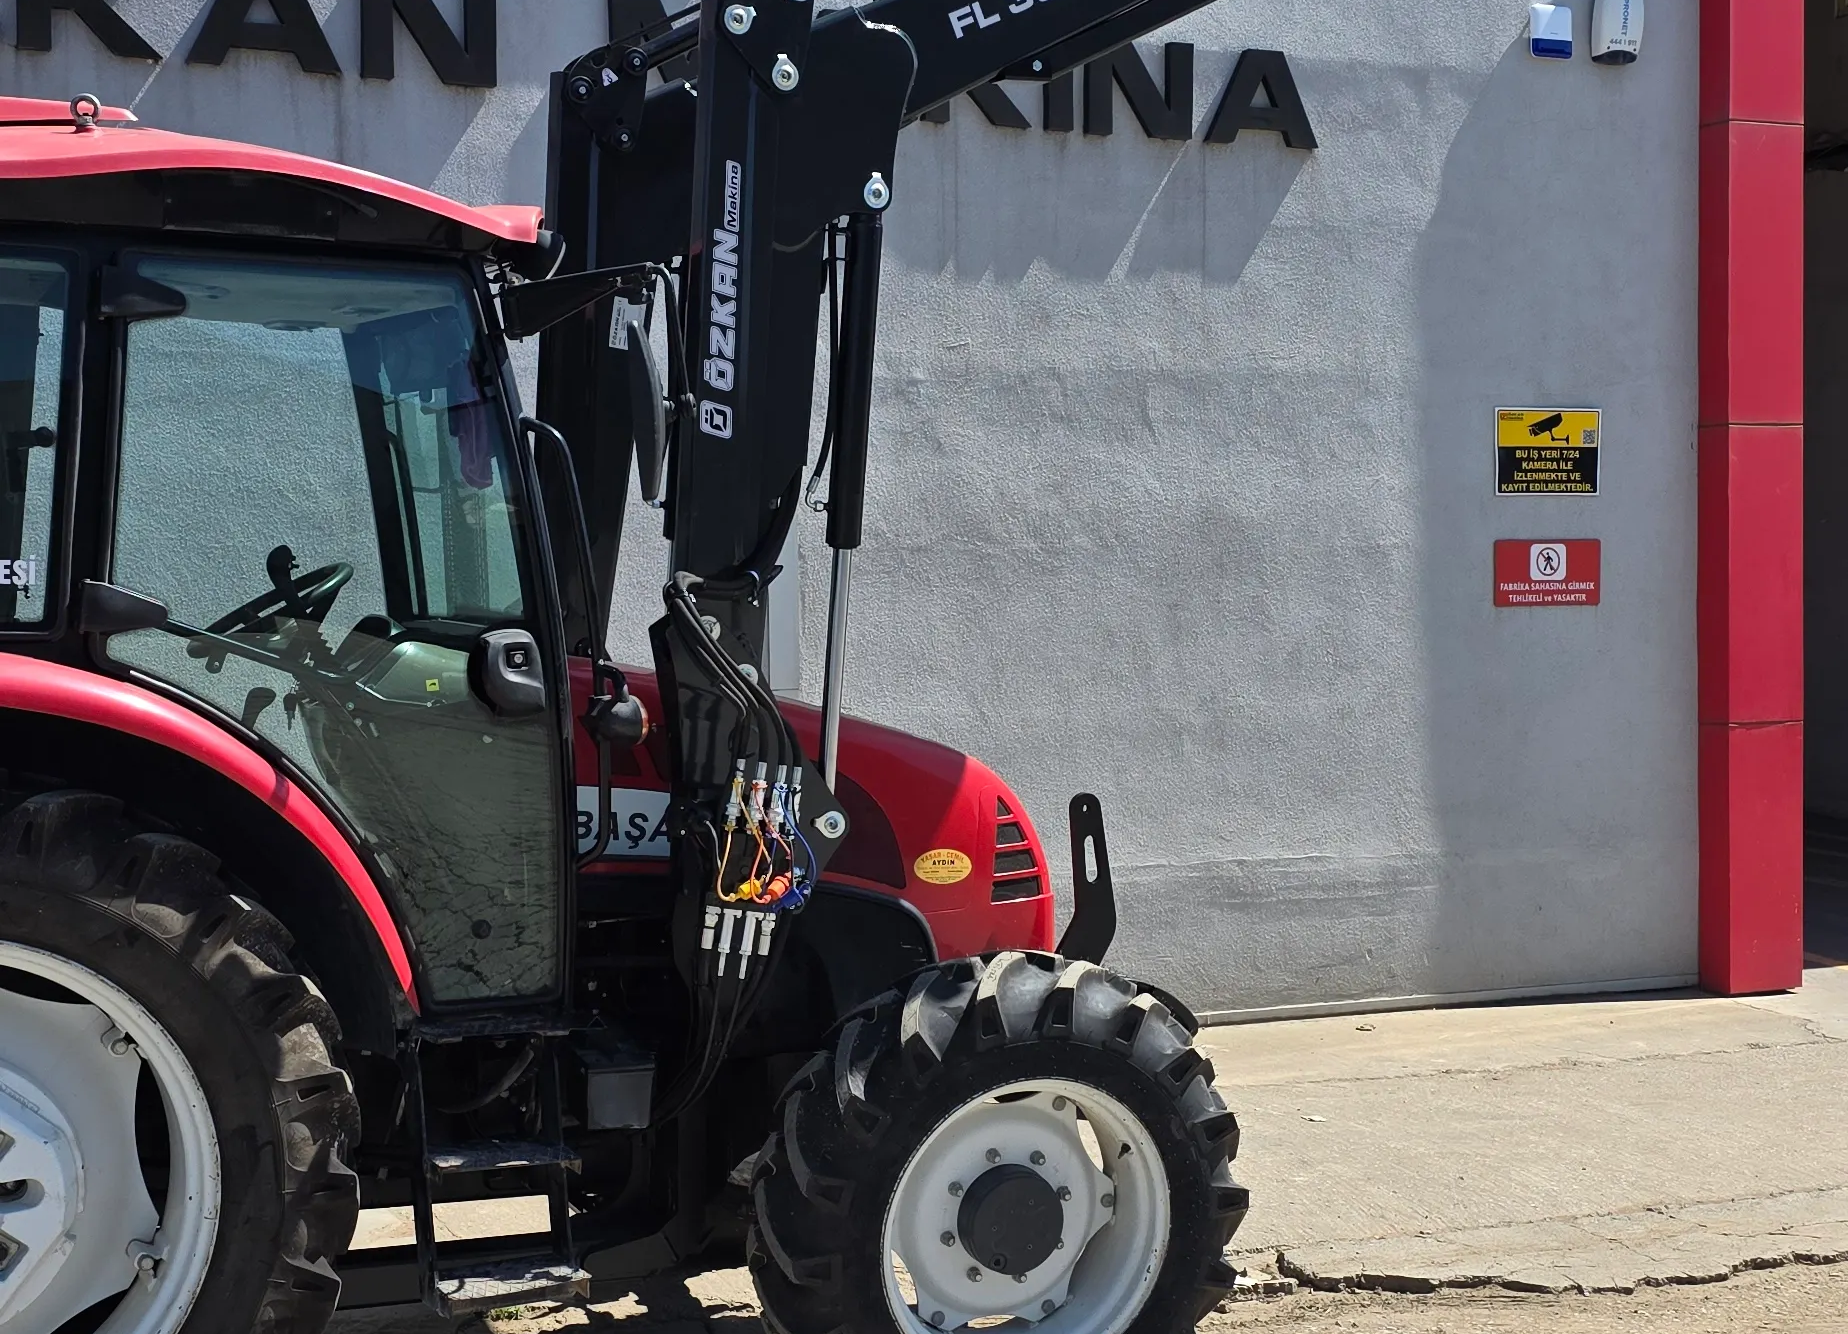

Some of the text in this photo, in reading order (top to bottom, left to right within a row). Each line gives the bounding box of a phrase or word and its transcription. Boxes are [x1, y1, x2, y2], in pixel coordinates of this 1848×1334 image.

[948, 1, 1001, 39] FL
[727, 164, 739, 228] Makina
[704, 229, 738, 392] ÖZKAN
[1515, 449, 1580, 460] BU İŞ YERİ 7/24
[1522, 460, 1573, 469] KAMERA İLE
[1514, 471, 1568, 480] İZLENMEKTE
[1501, 481, 1593, 492] KAYIT EDİLMEKTEDİR.
[1500, 580, 1595, 591] FABRİKA SAHASINA GİRMEK
[1508, 593, 1543, 602] TEHLİKELİ
[1553, 593, 1587, 602] YASAKTIR
